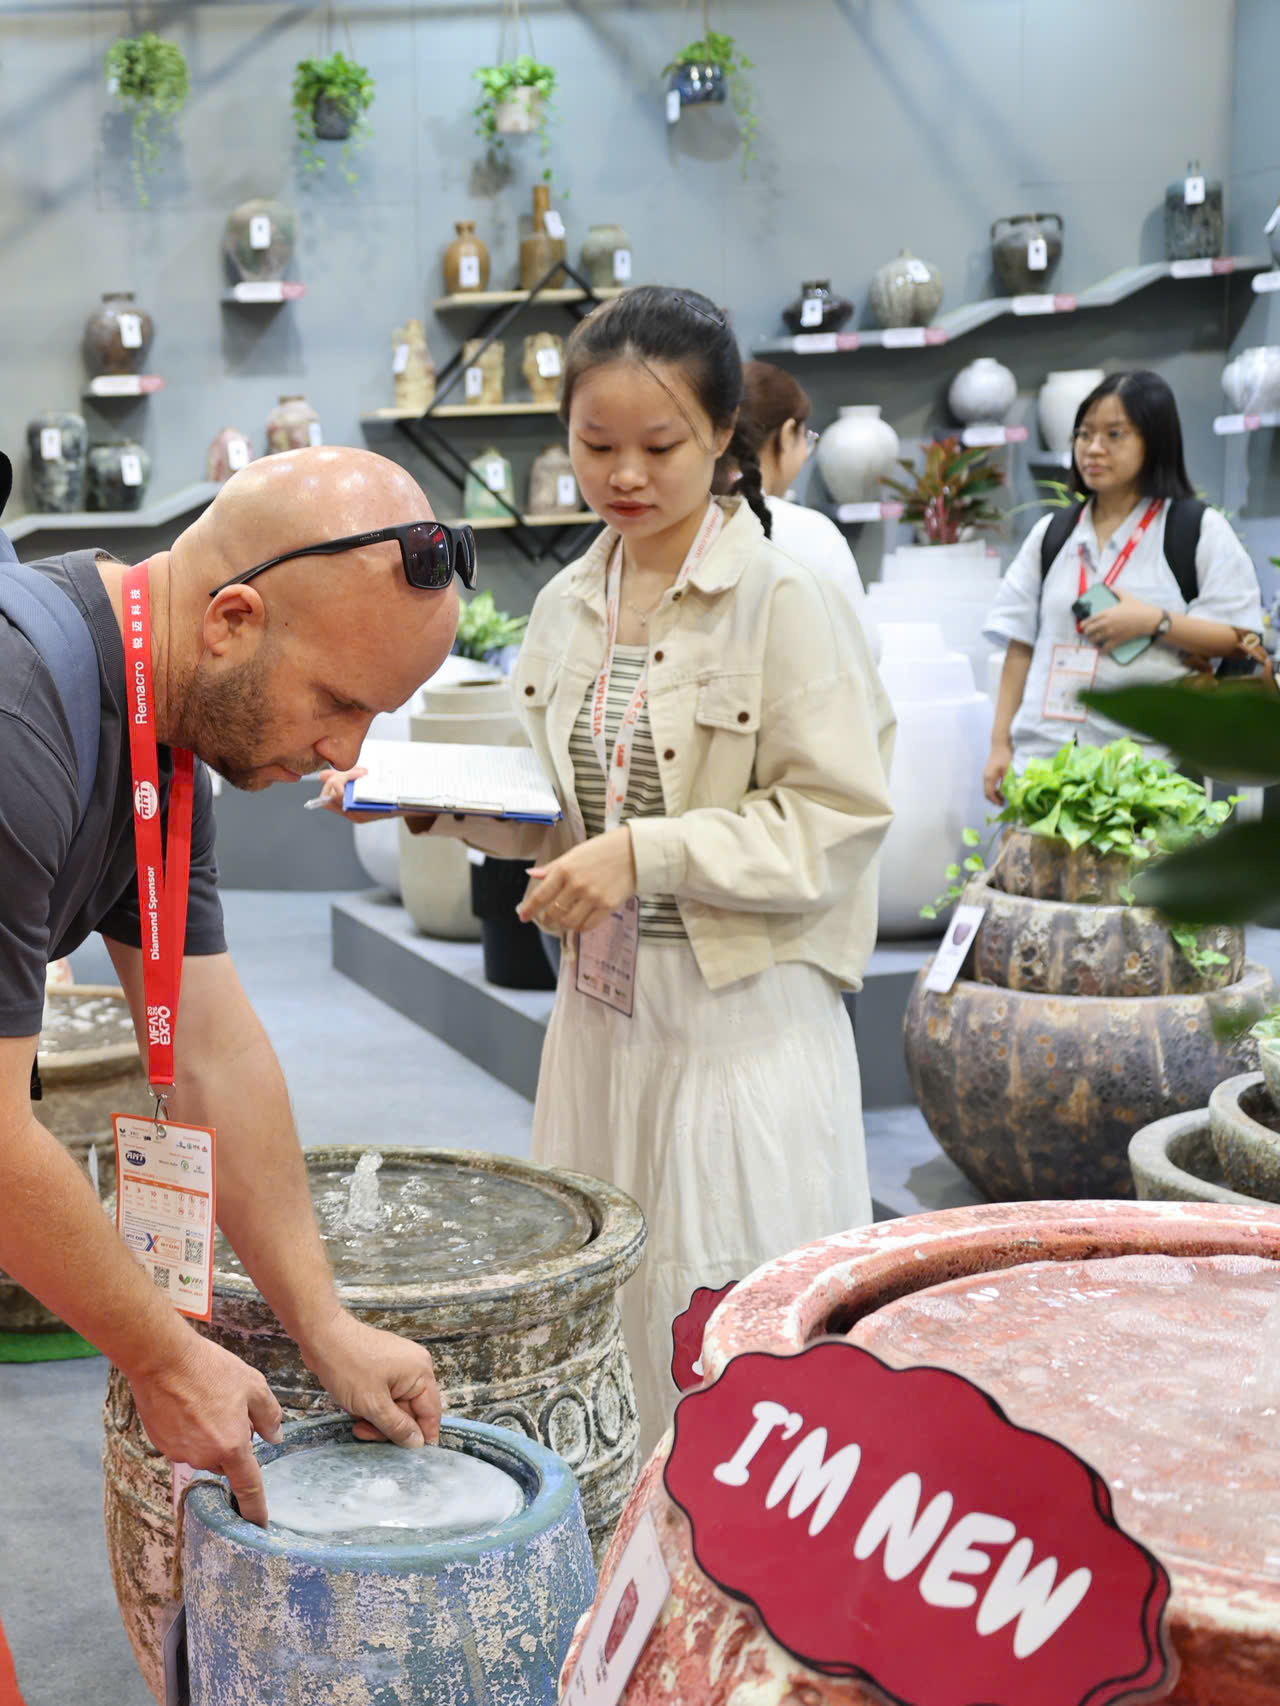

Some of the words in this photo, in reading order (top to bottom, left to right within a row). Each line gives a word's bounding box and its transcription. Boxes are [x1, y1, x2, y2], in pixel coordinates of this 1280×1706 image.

[134, 661, 148, 724] Remacro
[148, 866, 158, 910] Sponsor
[149, 912, 160, 960] Diamond
[149, 1016, 160, 1045] VIFA
[157, 1005, 171, 1046] EXPO
[713, 1400, 862, 1537] I'M
[853, 1471, 1093, 1659] NEW
